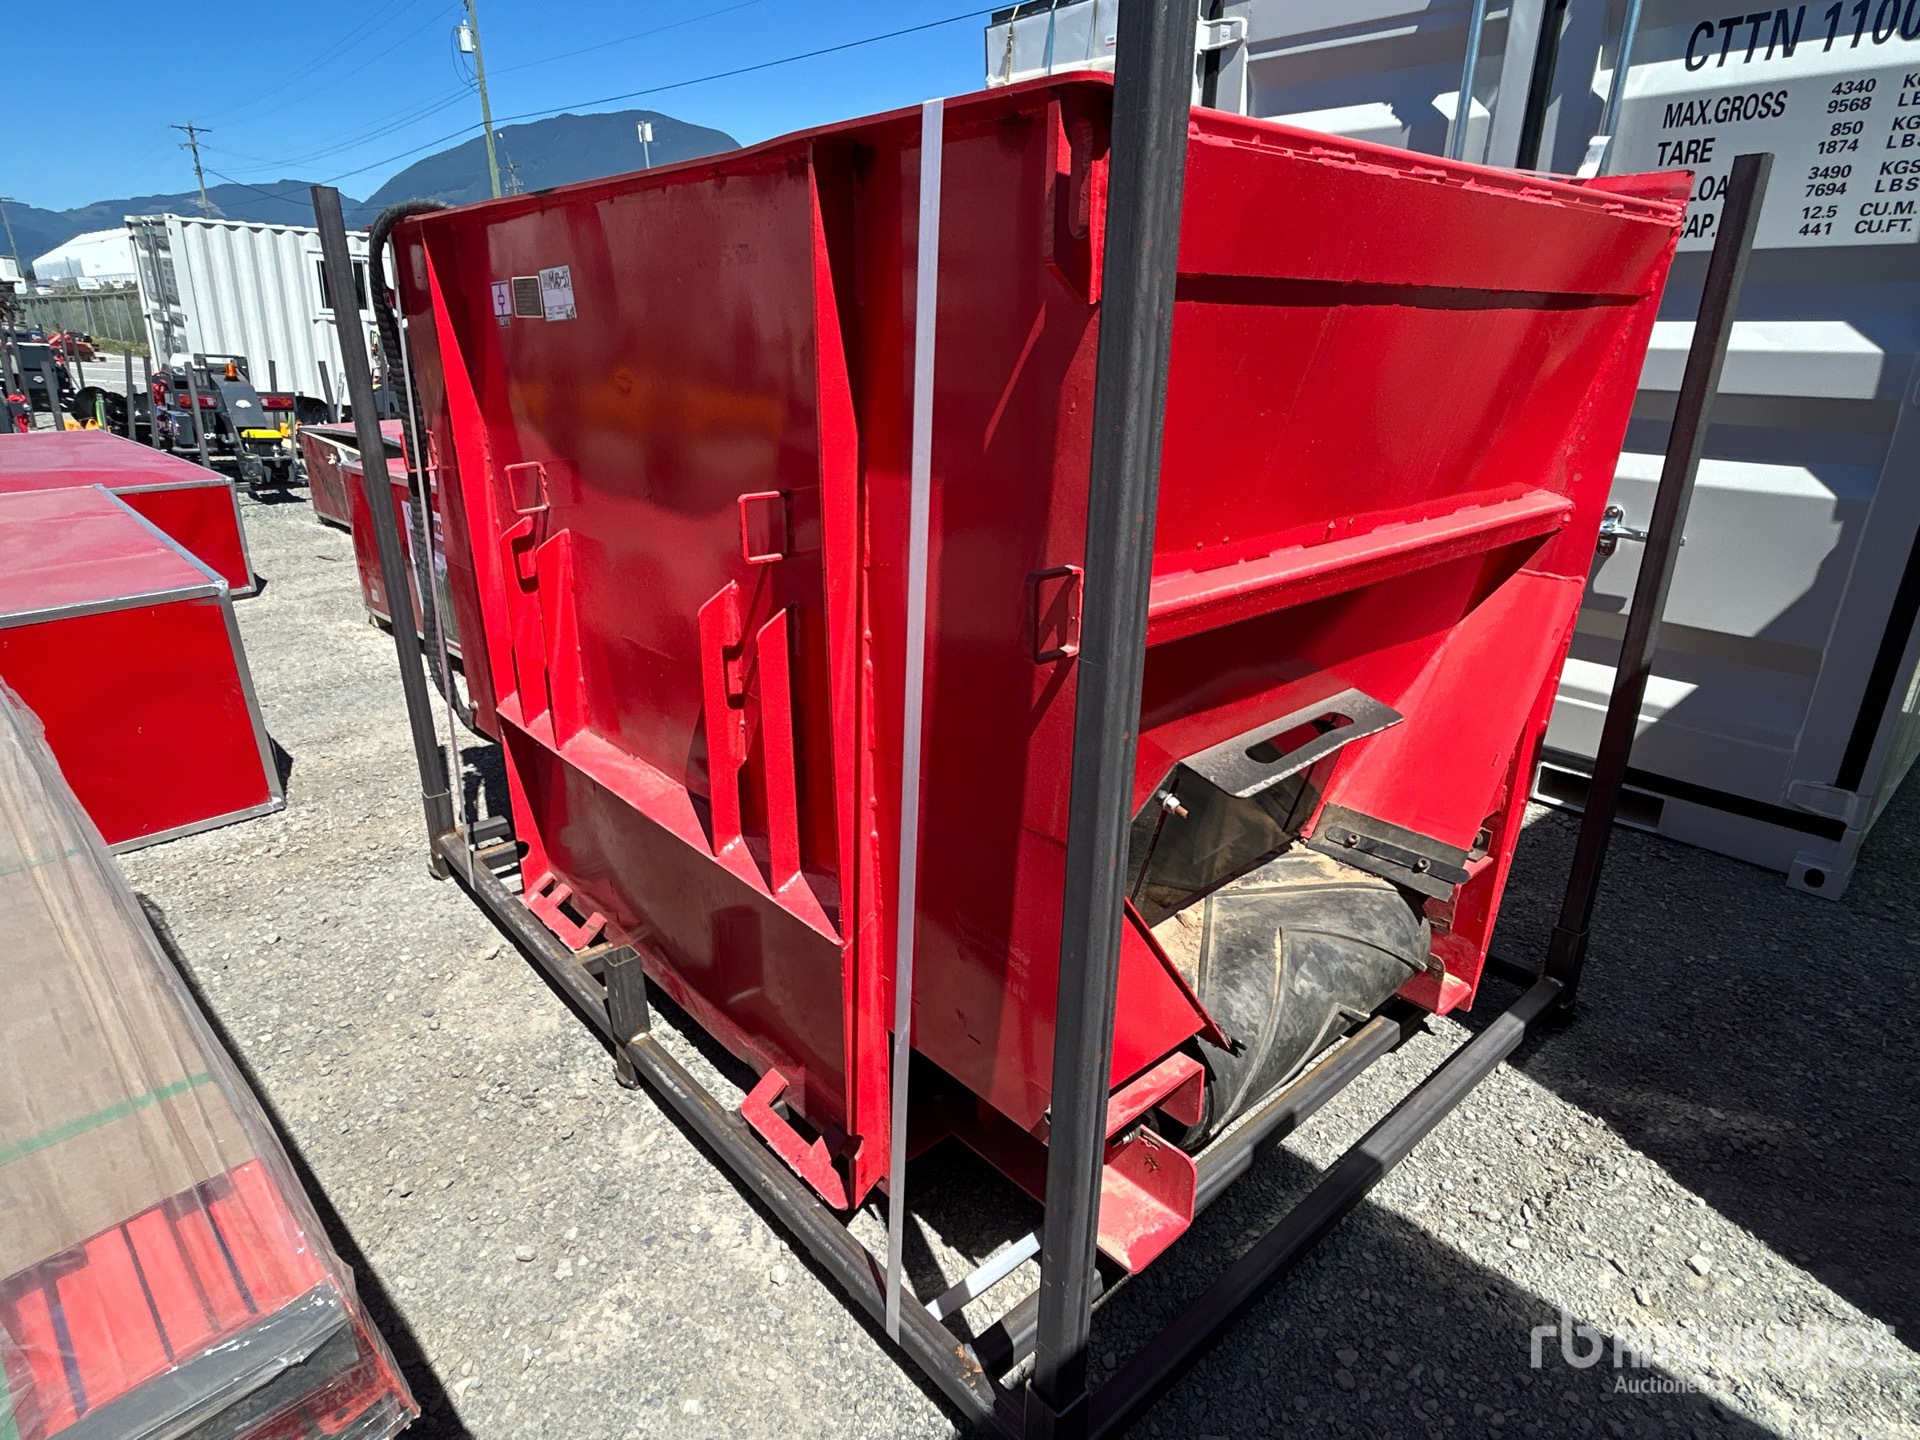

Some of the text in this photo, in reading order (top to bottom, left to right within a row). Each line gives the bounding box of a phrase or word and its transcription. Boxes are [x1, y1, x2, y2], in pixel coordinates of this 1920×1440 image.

[1685, 6, 1806, 72] CTTN
[1831, 78, 1877, 96] 4340
[1662, 90, 1788, 129] MAX.GROSS
[1826, 97, 1872, 114] 9568
[1830, 121, 1864, 137] 850
[1657, 137, 1716, 167] TARE
[1817, 134, 1920, 155] 1874 LB
[1808, 159, 1920, 180] 3490 KGS
[1805, 177, 1920, 197] 7694 LBS
[1802, 201, 1918, 220] 12.5 CU.M.
[1798, 218, 1912, 236] 441 CU.FT.
